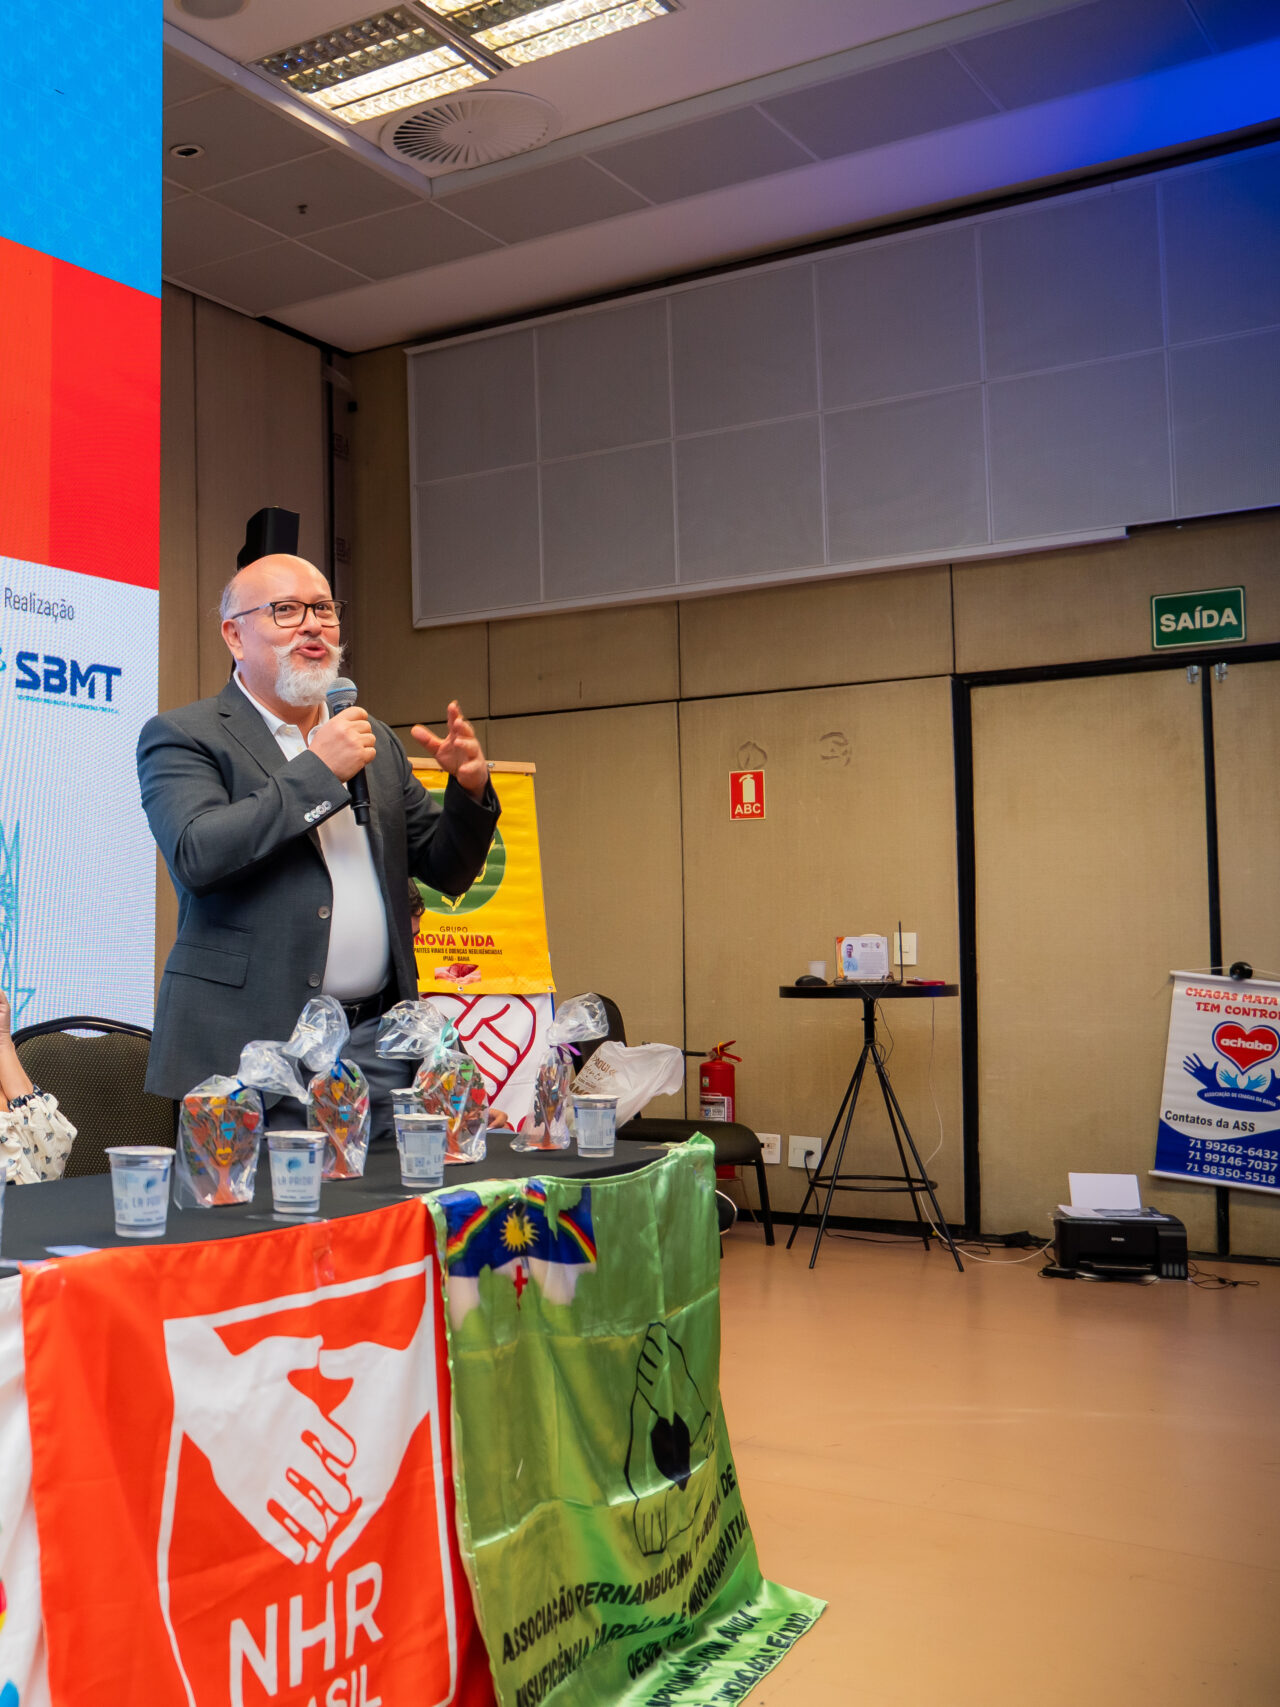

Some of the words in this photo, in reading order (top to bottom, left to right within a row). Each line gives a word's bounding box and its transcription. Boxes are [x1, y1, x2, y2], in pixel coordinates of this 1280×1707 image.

[4, 587, 75, 623] Realização
[1160, 605, 1238, 632] SAÍDA
[15, 651, 122, 702] SBMT
[735, 803, 761, 815] ABC
[415, 934, 456, 946] NOVA
[460, 935, 495, 947] VIDA
[1185, 987, 1238, 1001] CHAGAS
[1242, 994, 1278, 1006] MATA
[1196, 1002, 1220, 1013] TEM
[1221, 1038, 1272, 1051] achaba
[1165, 1110, 1212, 1126] Contatos
[1216, 1118, 1229, 1129] da
[1233, 1121, 1255, 1132] ASS
[1189, 1139, 1201, 1148] 71
[1205, 1141, 1278, 1160] 99262-6432
[1188, 1151, 1200, 1160] 71
[1205, 1153, 1278, 1172] 99146-7037
[1187, 1163, 1199, 1172] 71
[1202, 1164, 1275, 1184] 98350-5518
[230, 1561, 384, 1707] NHR
[503, 1586, 574, 1664] ASSOCIAÇÃO
